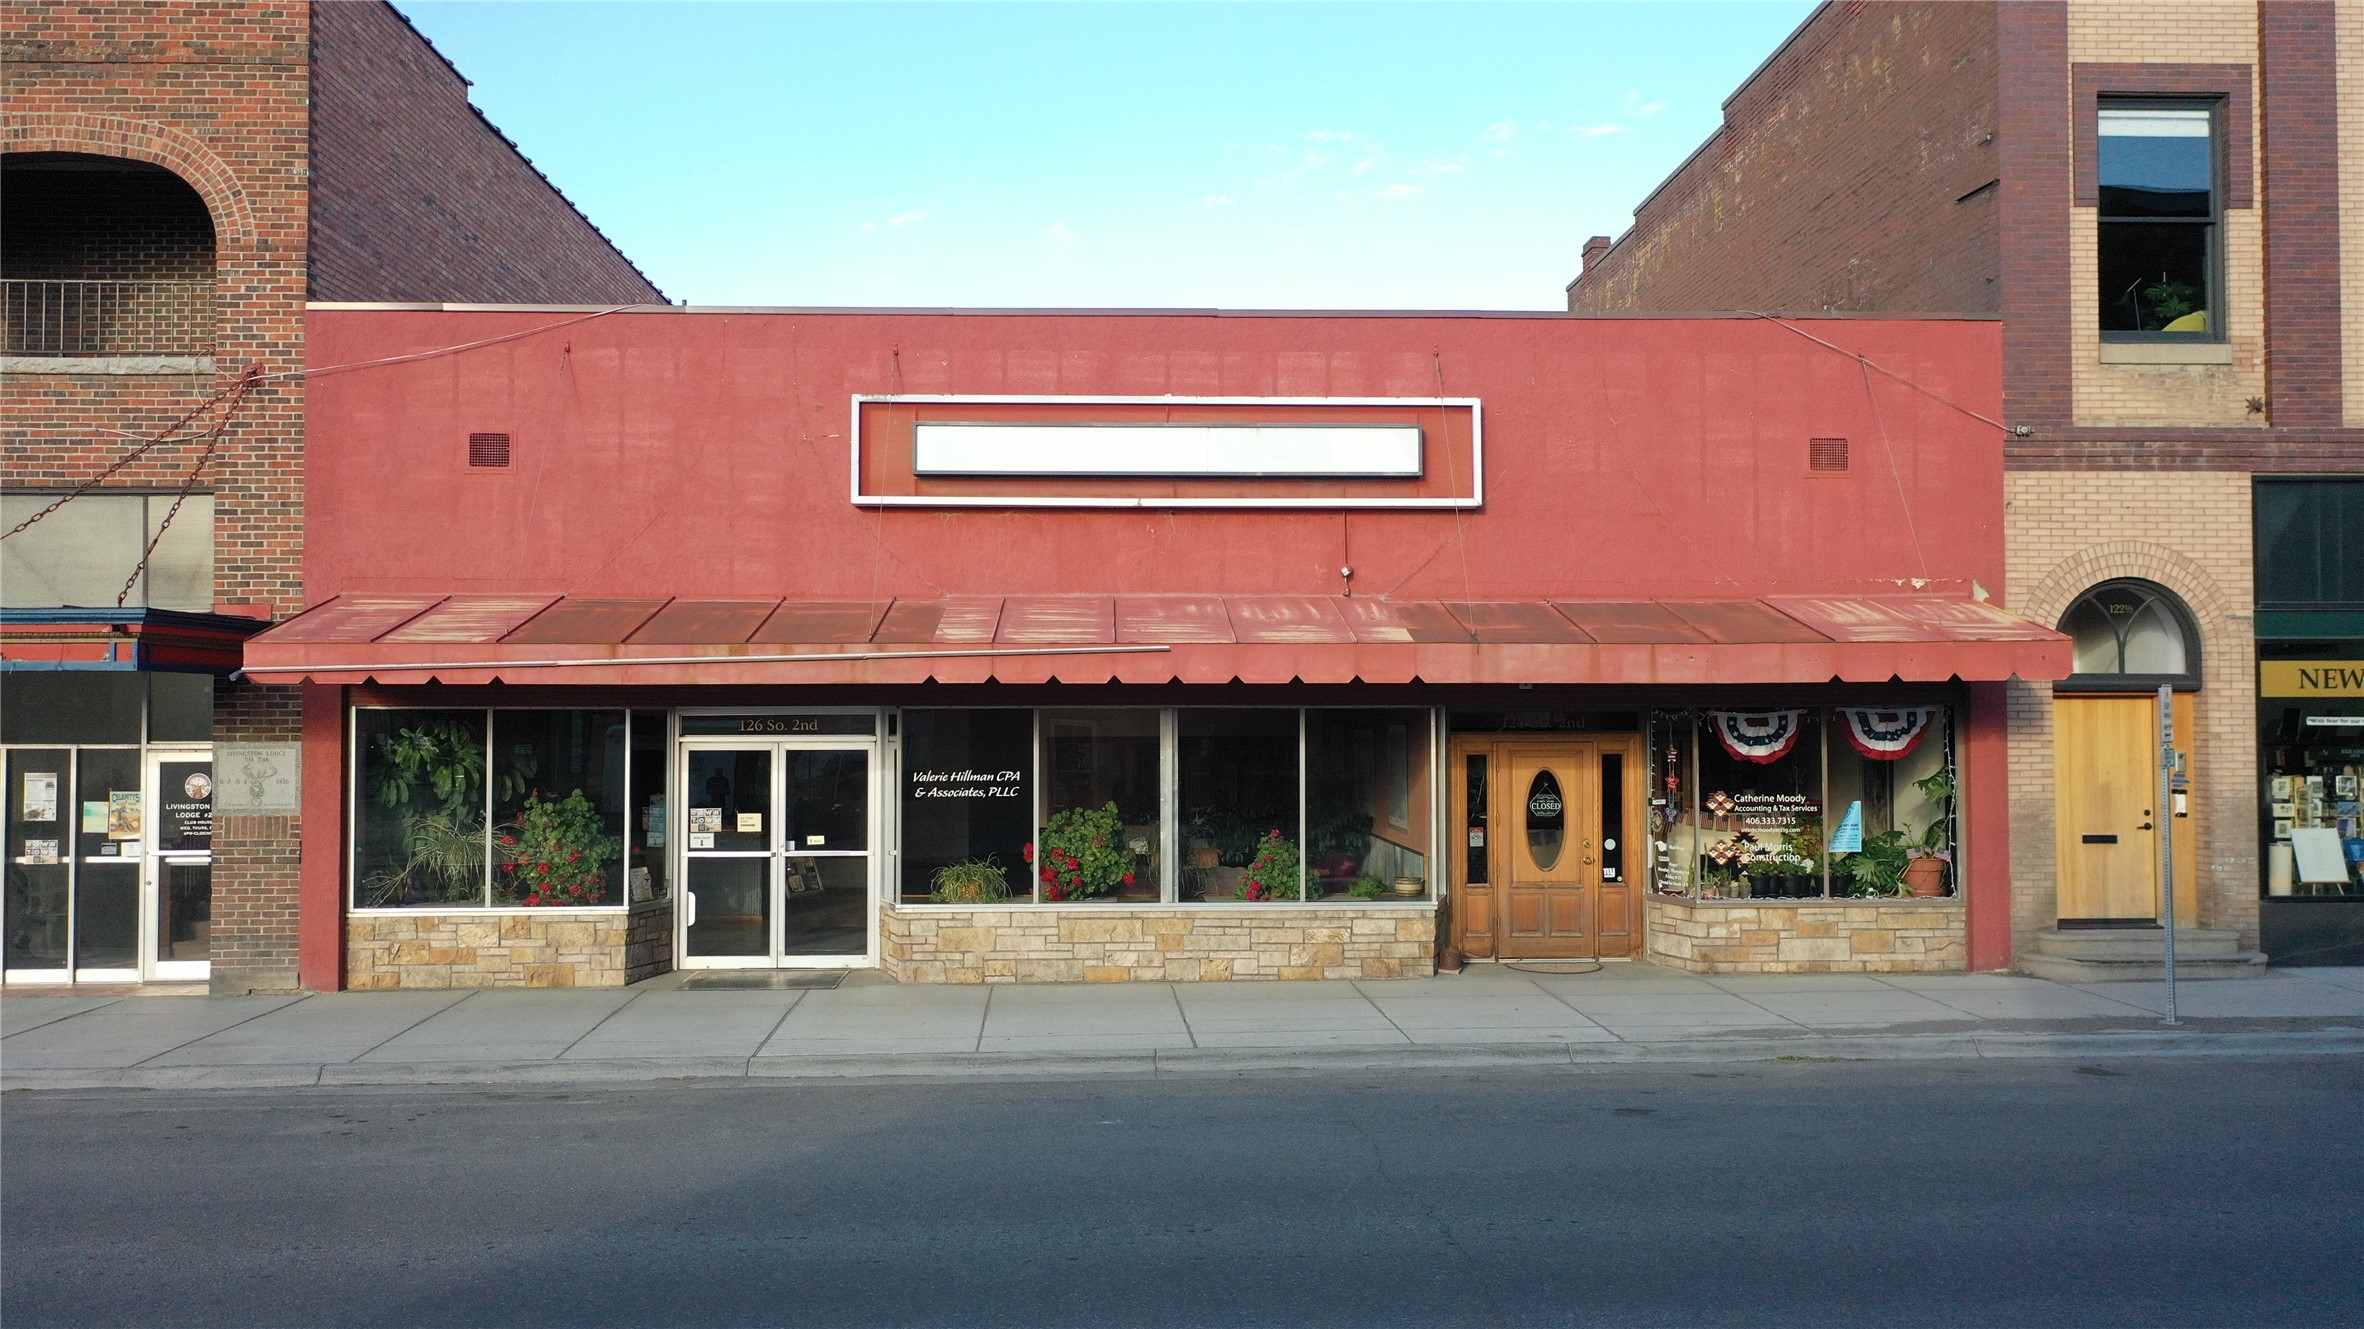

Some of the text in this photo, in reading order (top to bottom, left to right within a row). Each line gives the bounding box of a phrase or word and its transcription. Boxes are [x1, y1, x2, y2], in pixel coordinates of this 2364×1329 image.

[740, 719, 818, 731] 126 So. 2nd
[1559, 716, 1585, 728] 2nd
[913, 769, 1020, 782] Valerie Hillman CPA
[915, 786, 1020, 798] & Associates, PLLC
[1734, 794, 1806, 804] Catherine Moody
[1734, 805, 1772, 813] Accounting
[1745, 817, 1796, 825] 406.333.7315
[1744, 843, 1793, 851] Paul Morris
[1744, 853, 1801, 861] Construction
